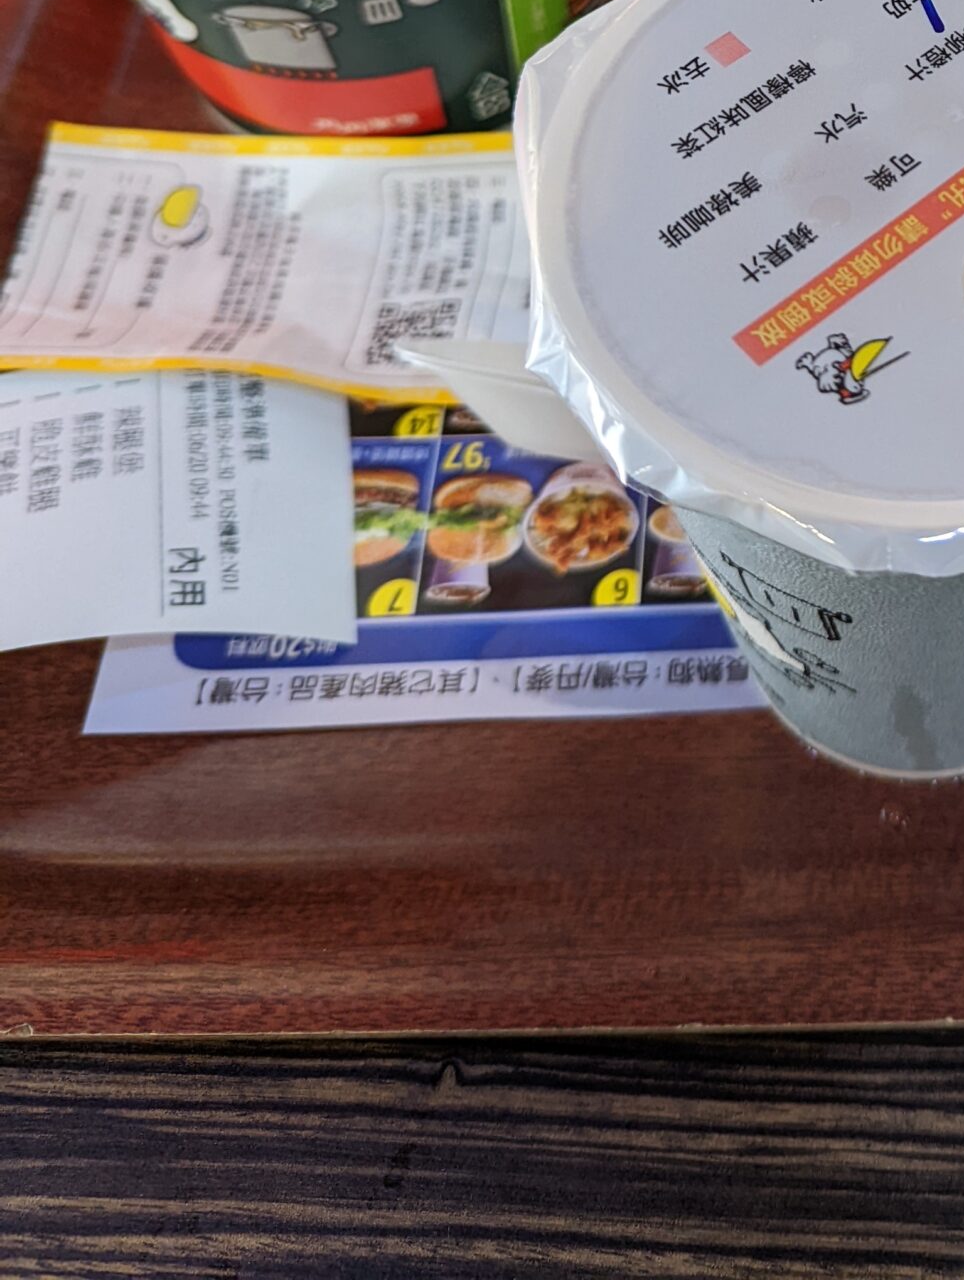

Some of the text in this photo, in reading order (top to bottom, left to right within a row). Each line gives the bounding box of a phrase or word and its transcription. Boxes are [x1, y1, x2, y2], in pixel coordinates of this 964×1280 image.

[655, 54, 712, 97] 去冰
[669, 58, 818, 161] 檸檬風味紅茶
[812, 101, 869, 145] 汽水
[862, 152, 923, 193] 可樂
[738, 220, 820, 284] 蘋果汁
[167, 547, 207, 607] 內用
